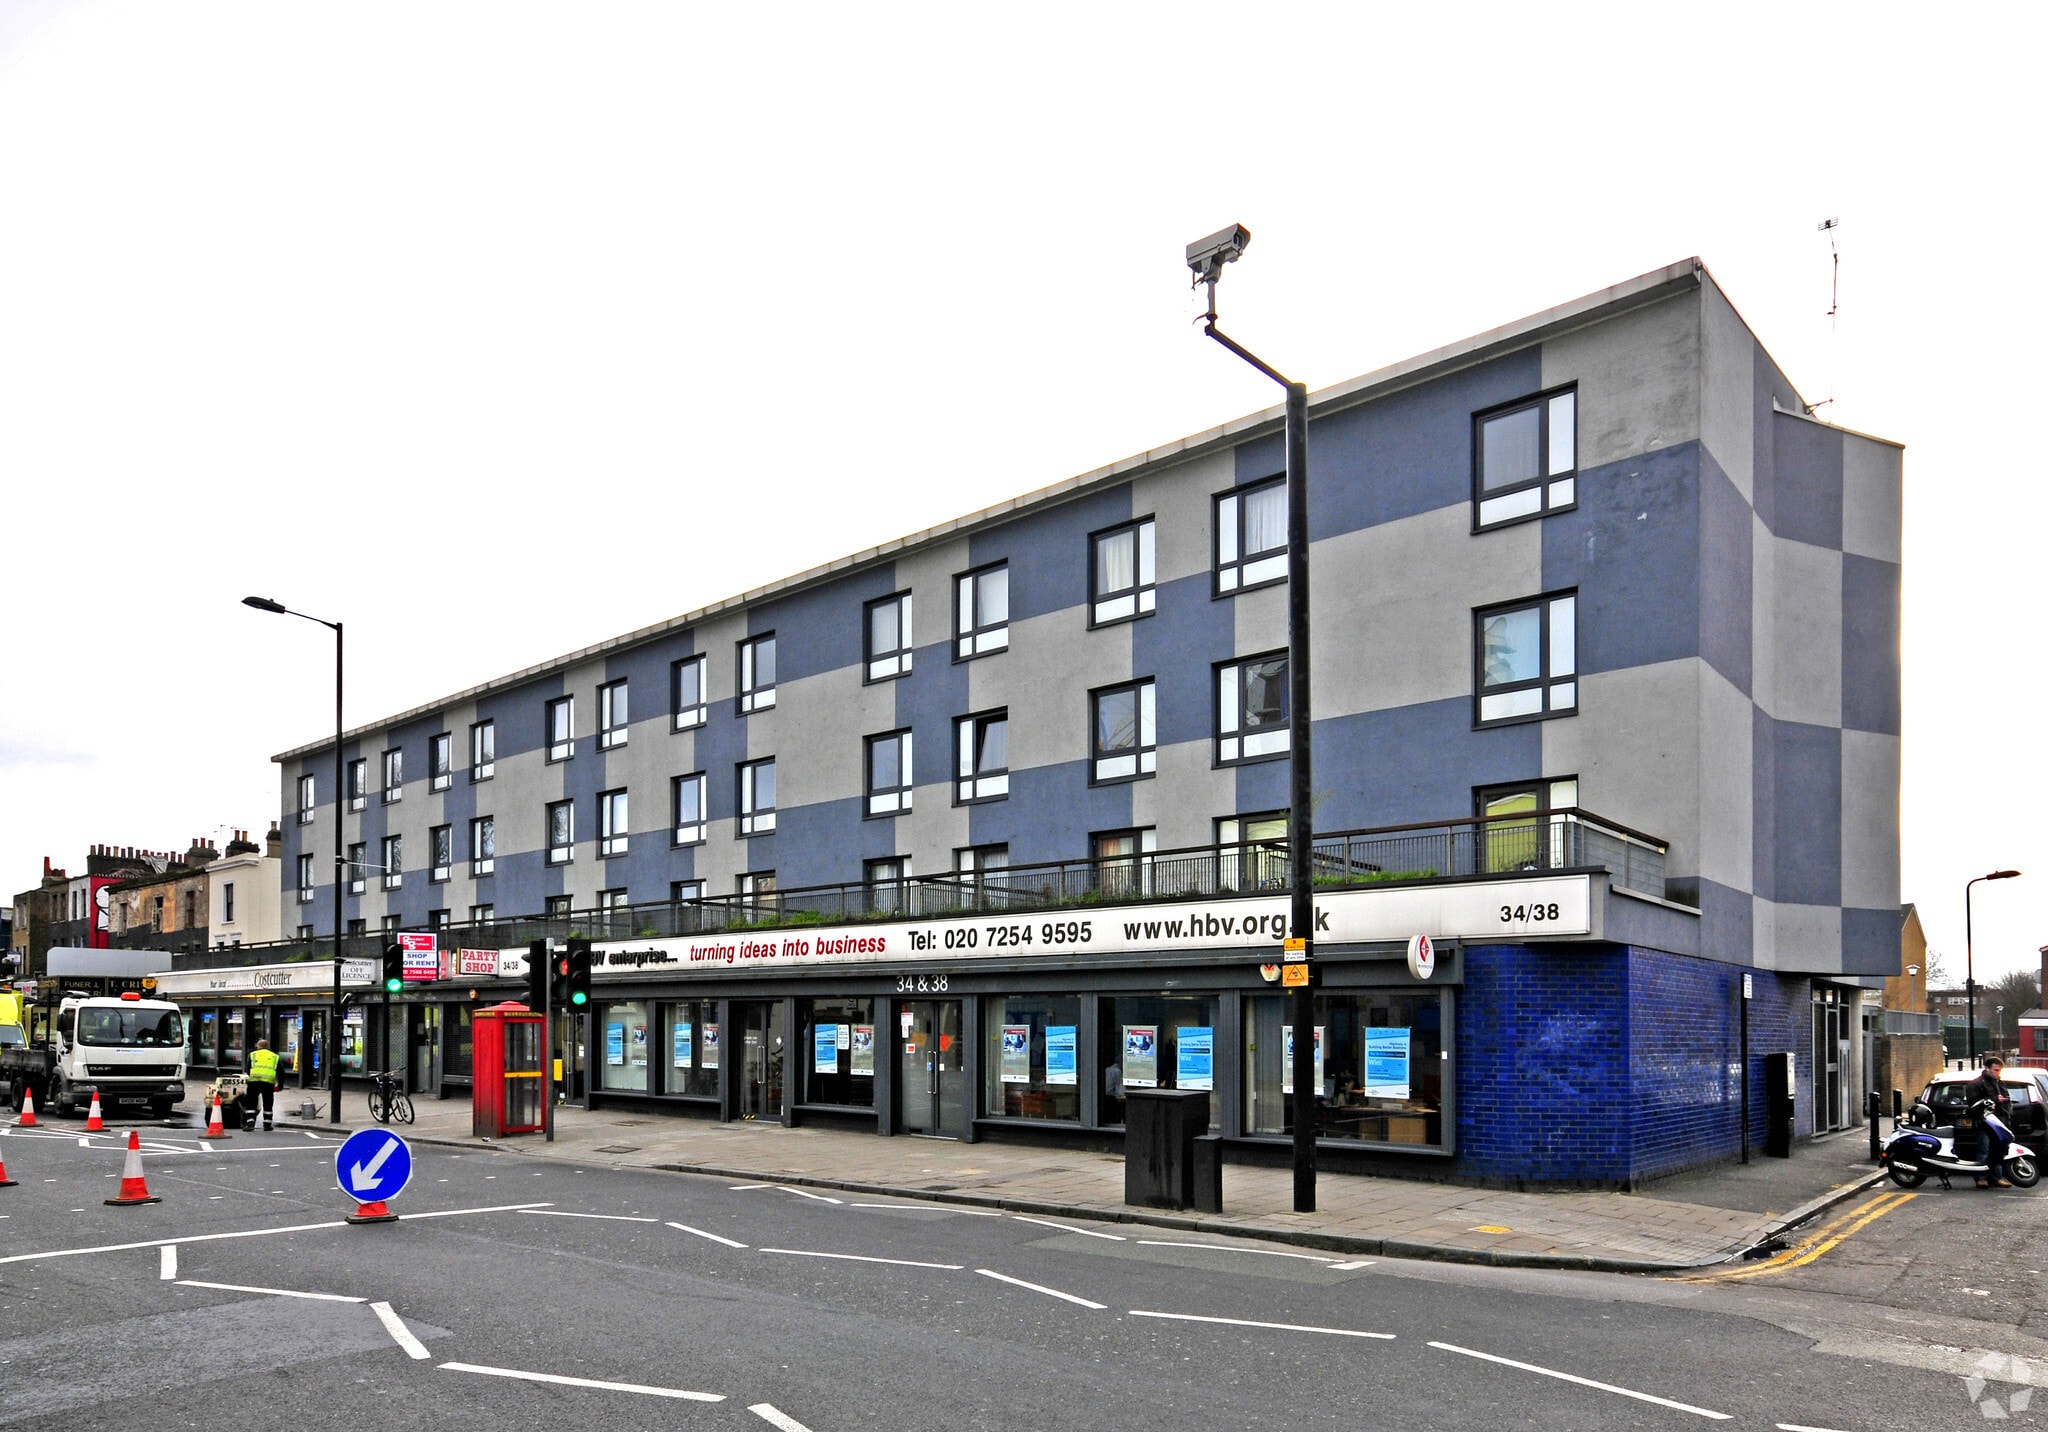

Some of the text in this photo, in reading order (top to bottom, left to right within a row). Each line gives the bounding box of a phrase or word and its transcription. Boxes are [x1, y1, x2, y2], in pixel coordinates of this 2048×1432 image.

[1500, 903, 1559, 923] 34/38
[1124, 907, 1329, 940] www.hbv.org.k
[908, 921, 1093, 951] Tel: 020 7254 9595
[462, 950, 497, 962] PARTY
[609, 947, 678, 968] enterprise...
[690, 935, 887, 964] turning ideas into business
[465, 962, 494, 973] SHOP
[503, 960, 518, 971] 34/38
[254, 971, 292, 988] Costcutter
[897, 974, 948, 992] 34 & 38
